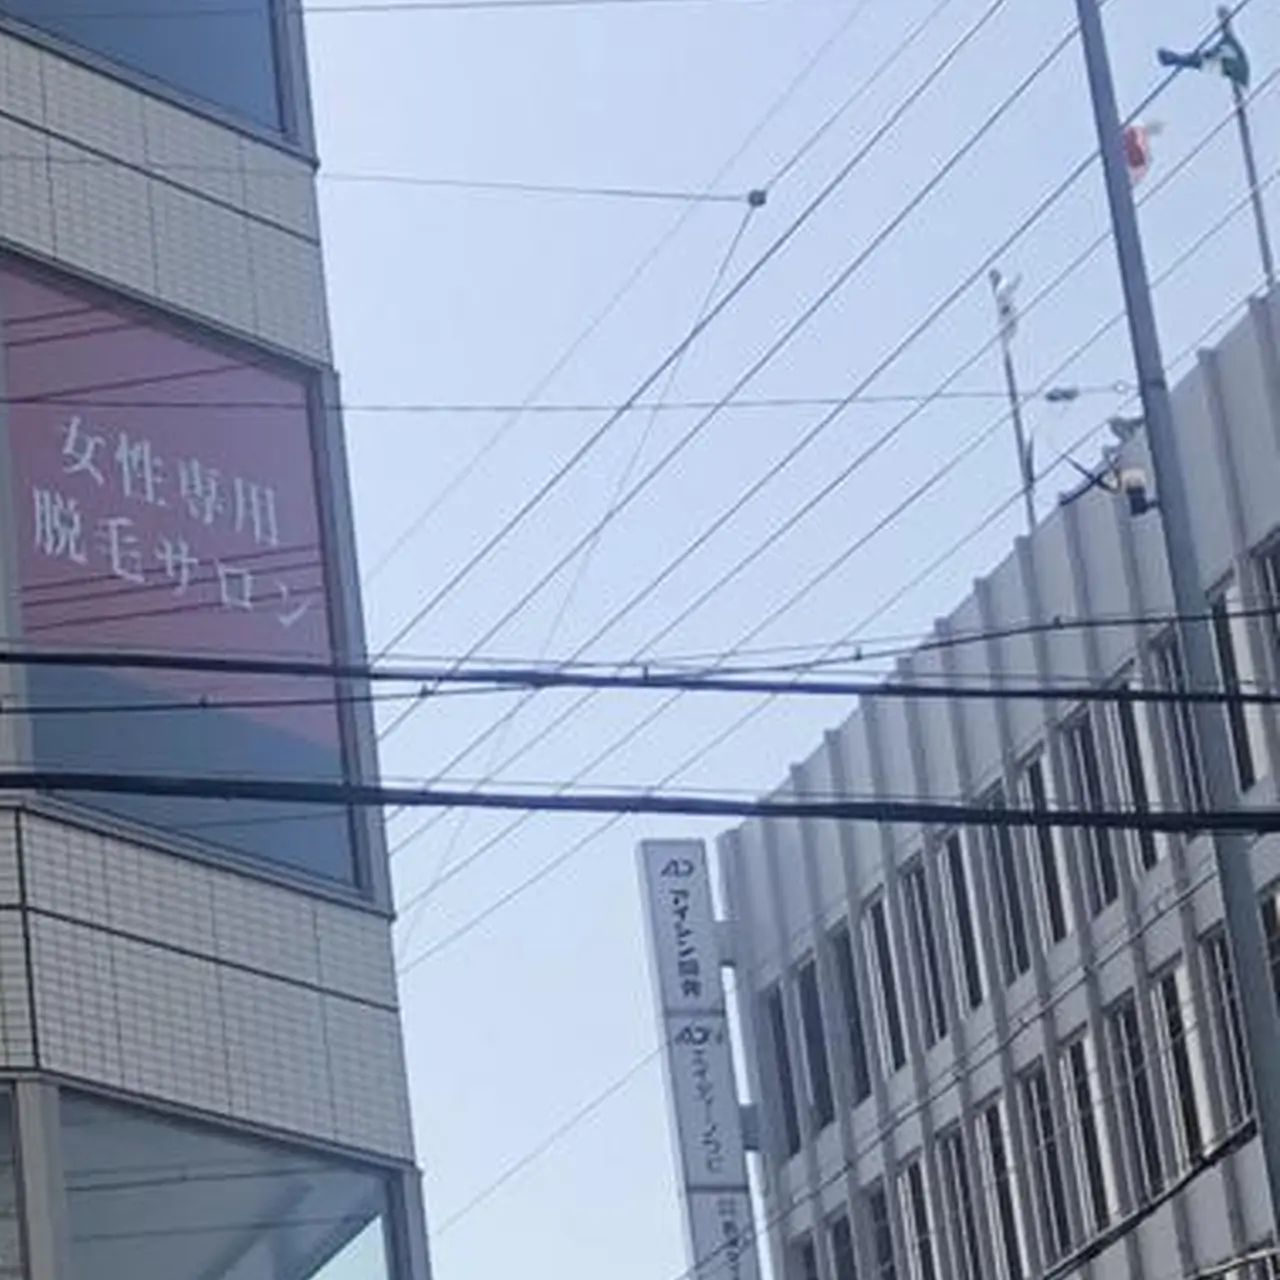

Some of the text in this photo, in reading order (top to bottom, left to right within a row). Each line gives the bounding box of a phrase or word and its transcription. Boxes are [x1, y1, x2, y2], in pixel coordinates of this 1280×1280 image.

[59, 414, 279, 548] 女性専用
[31, 484, 312, 627] 脱毛サロン
